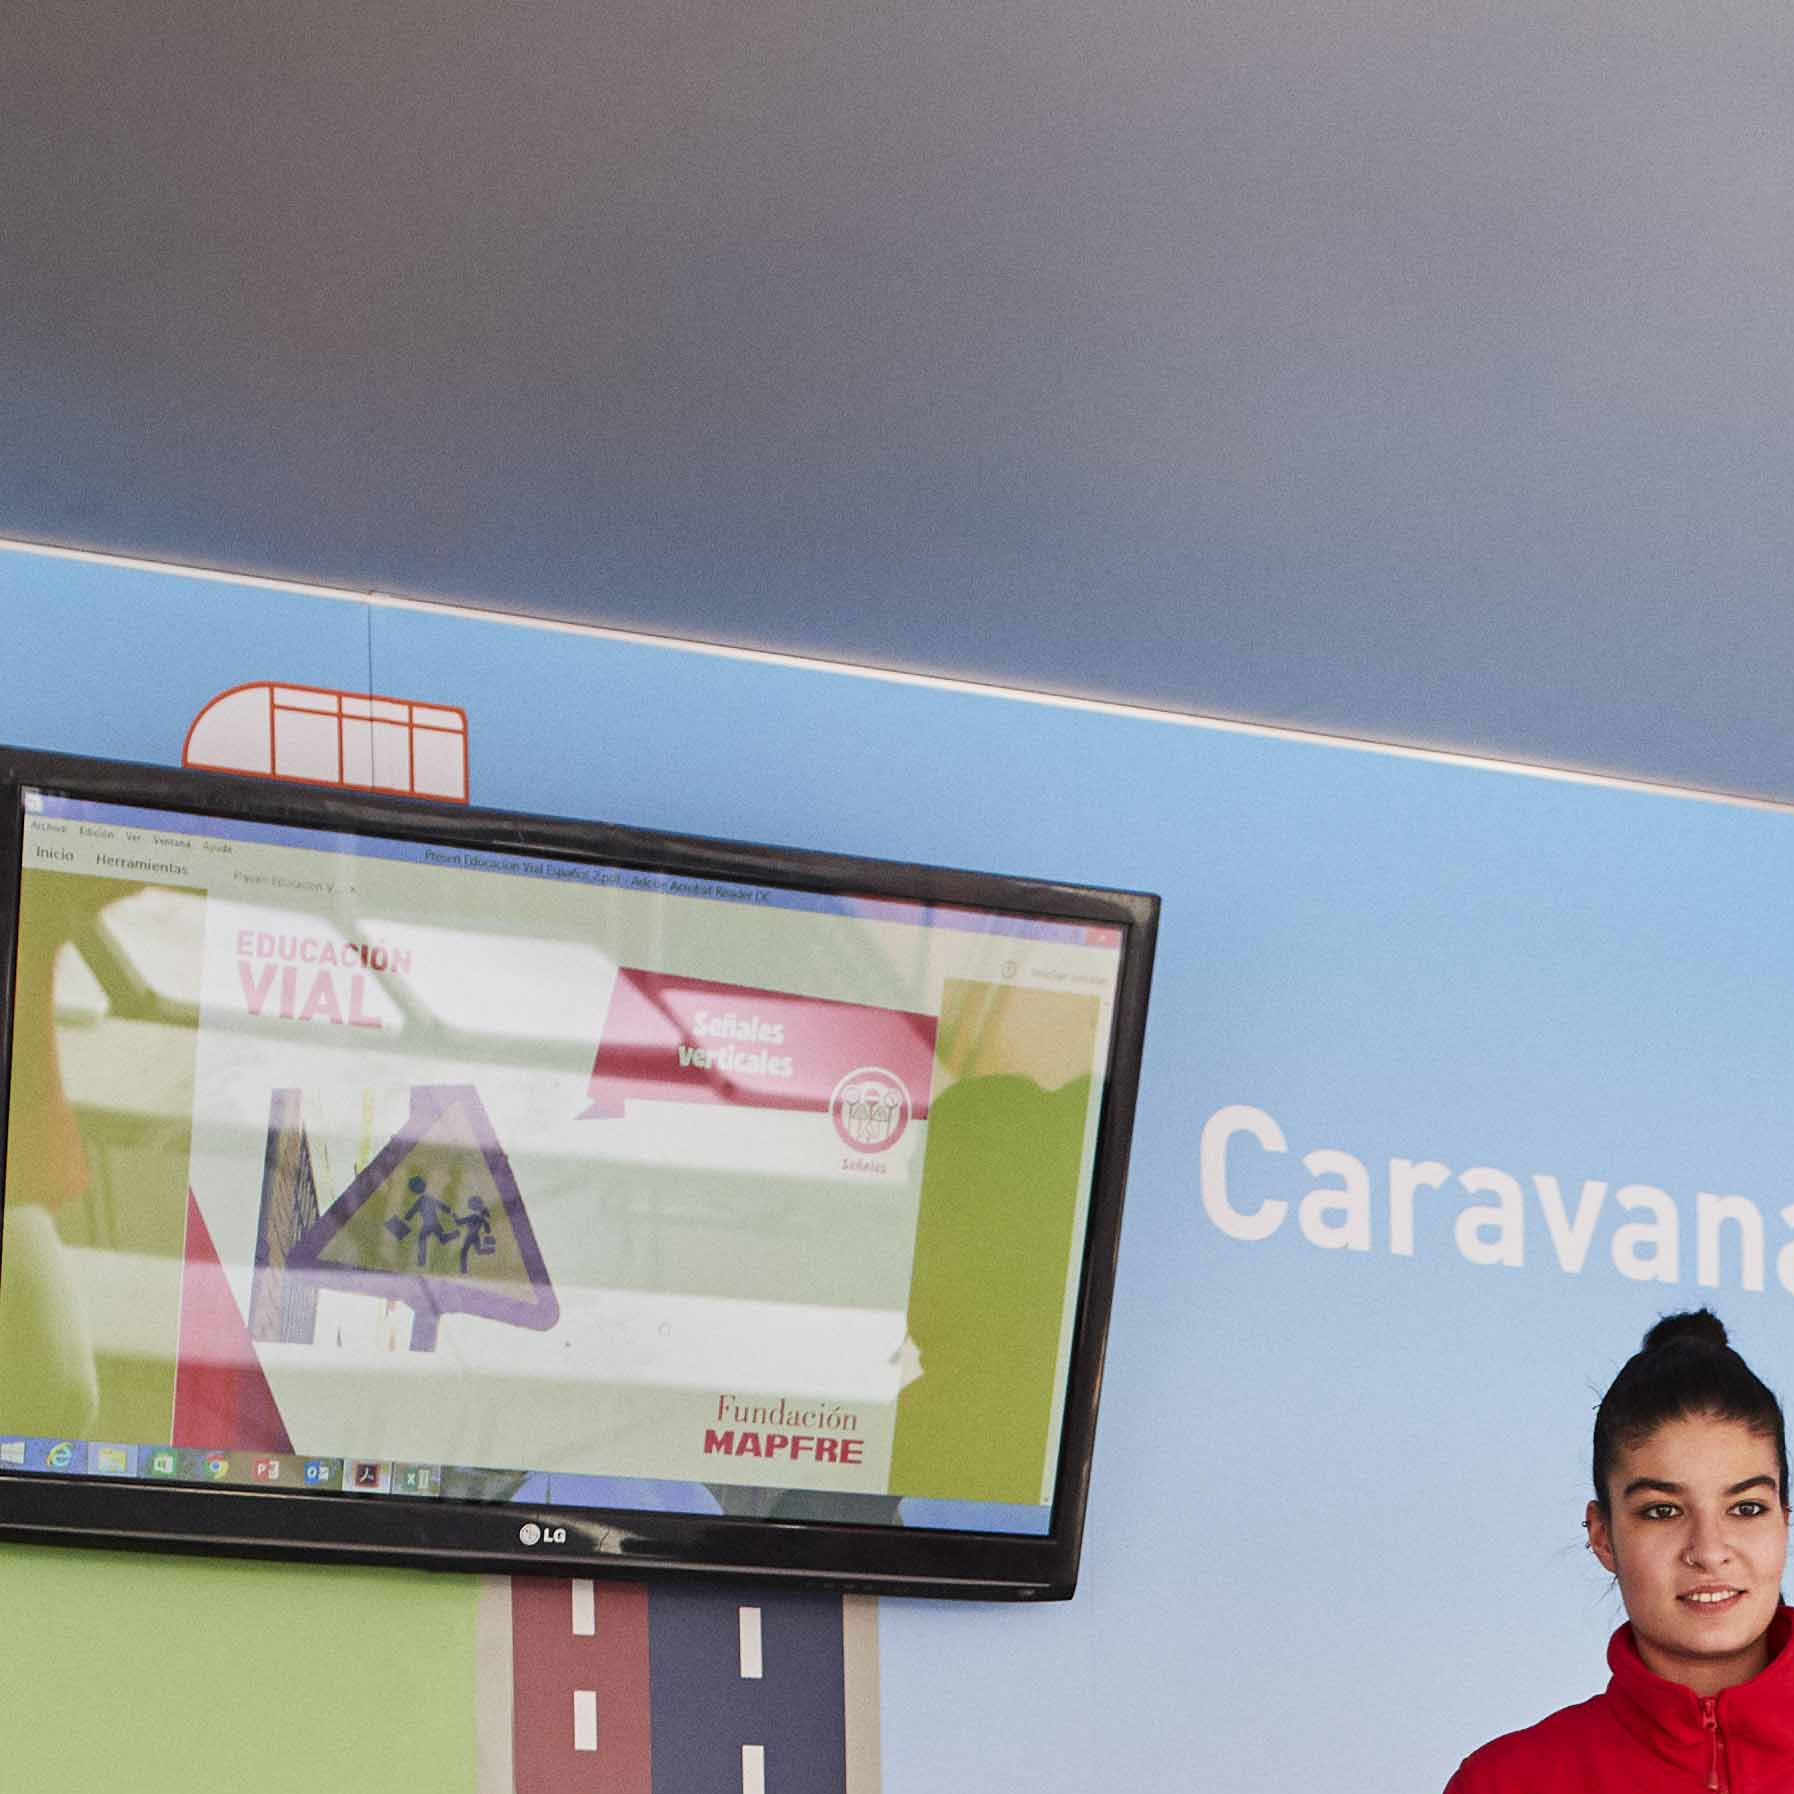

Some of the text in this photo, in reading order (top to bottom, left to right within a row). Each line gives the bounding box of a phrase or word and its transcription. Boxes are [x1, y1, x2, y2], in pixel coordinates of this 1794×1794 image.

[35, 844, 189, 876] Inicio Herramientas
[236, 928, 412, 975] EDUCACIÓN
[237, 958, 384, 1029] VIAL
[692, 1009, 785, 1045] Señales
[716, 1394, 858, 1431] Fundación
[702, 1428, 865, 1465] MAPFRE
[543, 1527, 567, 1544] LG
